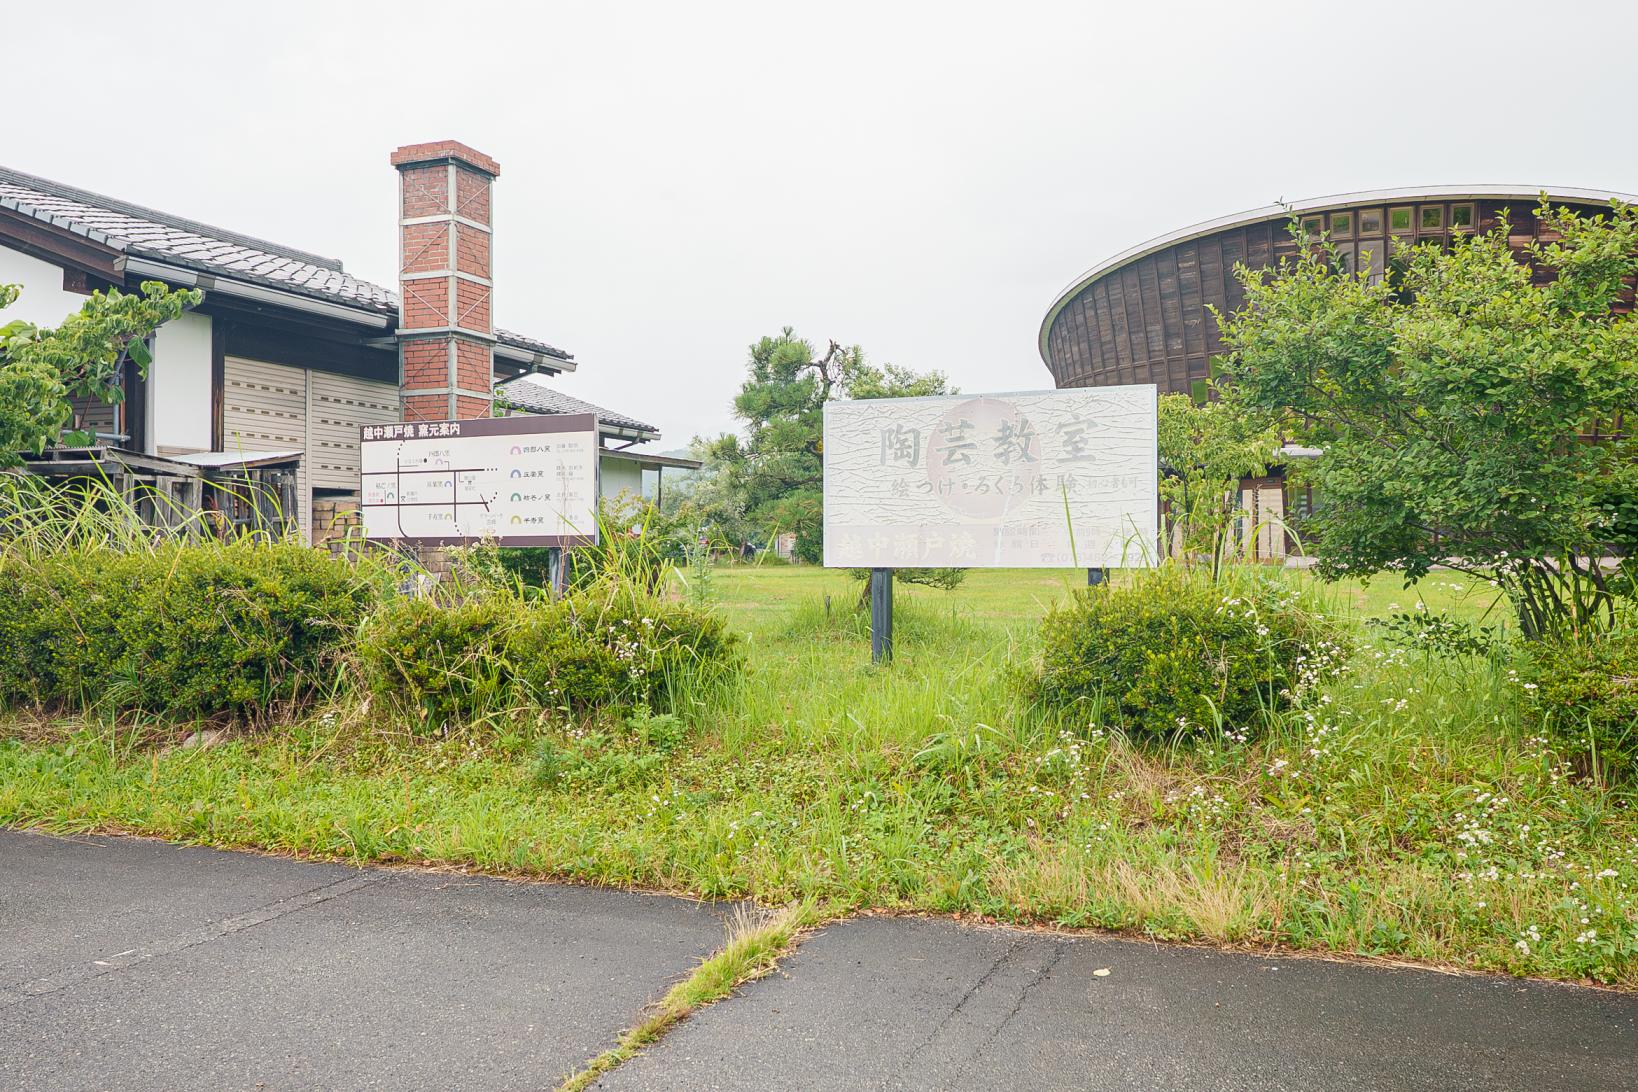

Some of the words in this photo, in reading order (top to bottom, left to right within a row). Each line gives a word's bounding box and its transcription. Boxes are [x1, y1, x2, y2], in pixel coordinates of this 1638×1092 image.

[363, 424, 415, 440] 越中瀬戸焼
[418, 422, 461, 438] 窯元案内
[879, 413, 1098, 468] 陶芸教室
[890, 474, 1080, 497] 絵つけ・ろくろ体験
